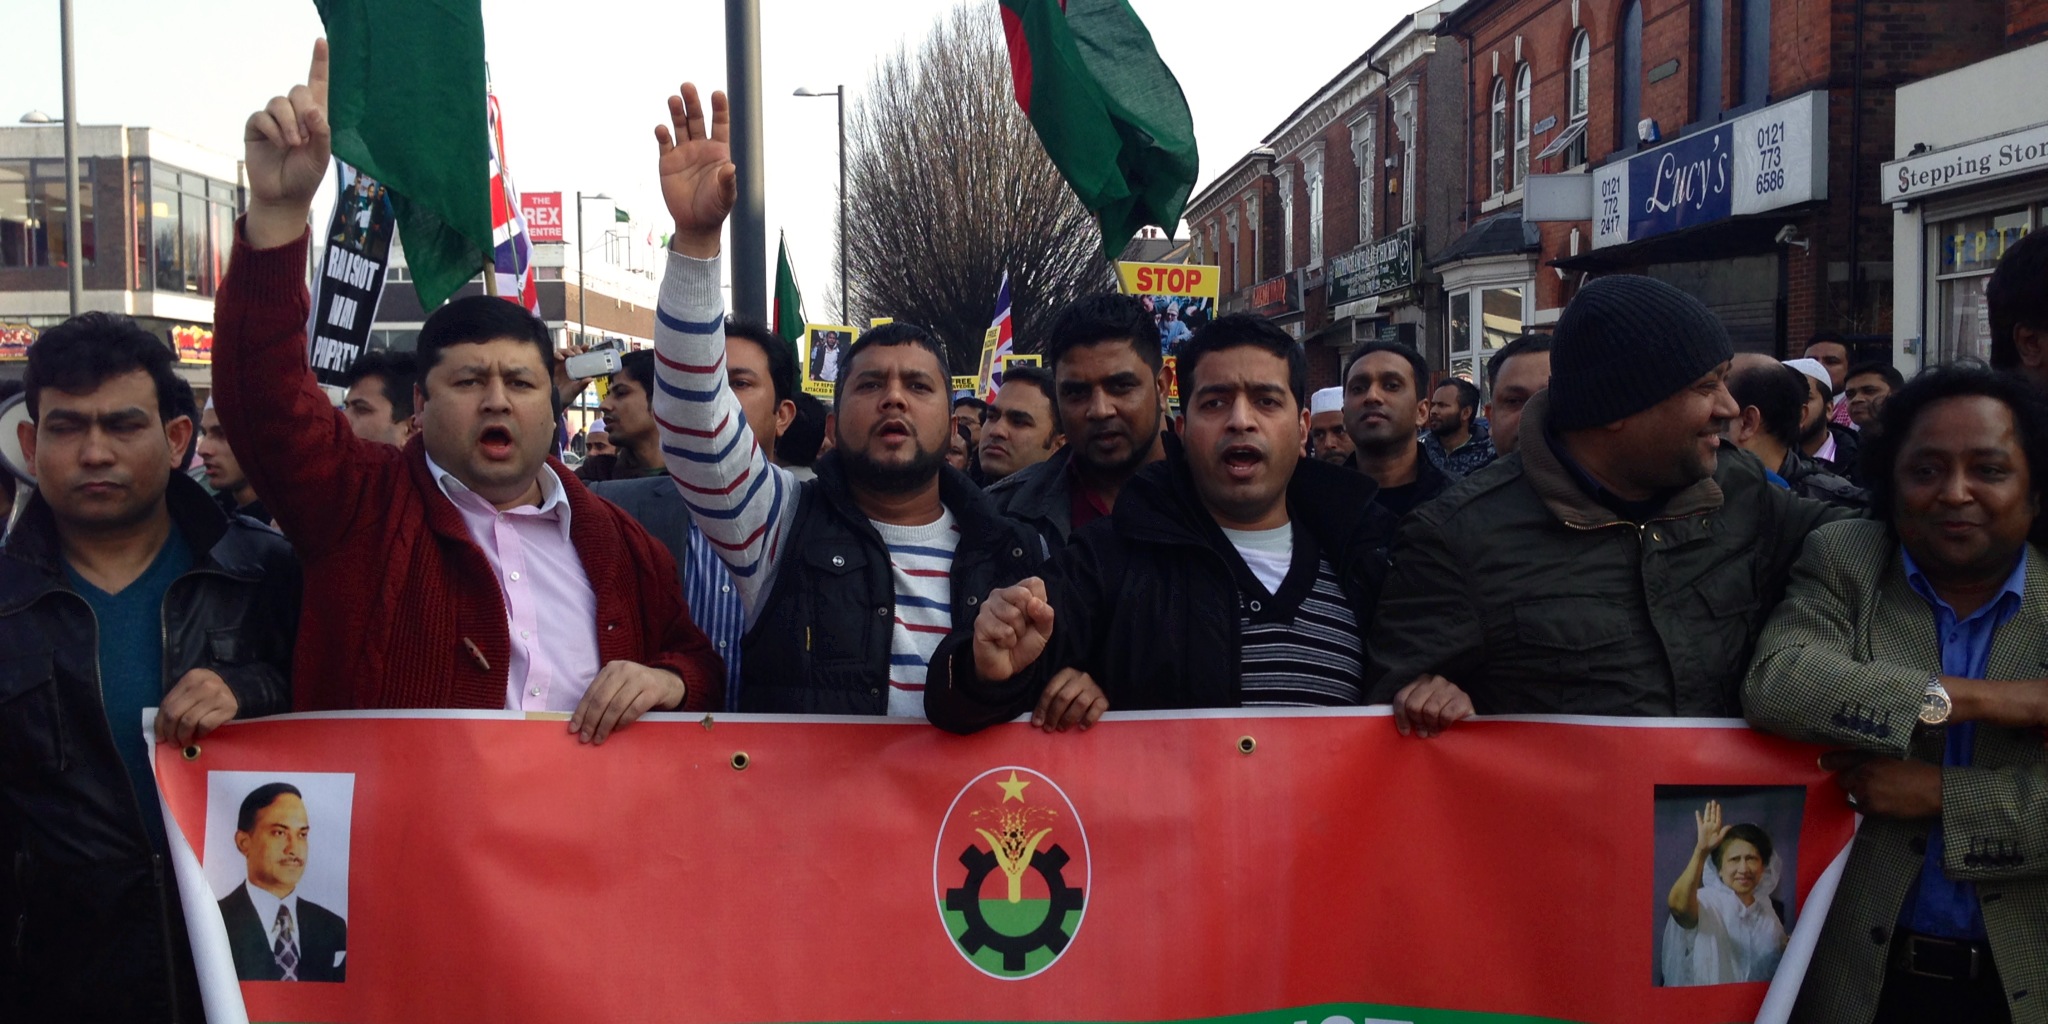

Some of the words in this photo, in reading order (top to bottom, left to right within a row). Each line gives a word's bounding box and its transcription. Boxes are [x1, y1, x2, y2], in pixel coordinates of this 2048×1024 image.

[1757, 121, 1785, 149] 0121
[1760, 145, 1782, 171] 773
[1645, 134, 1728, 214] Lucy's
[1756, 169, 1785, 195] 6586
[1898, 154, 1991, 193] Stepping
[1601, 176, 1621, 198] 0121
[531, 197, 551, 205] THE
[1603, 196, 1618, 217] 772
[523, 207, 560, 226] REX
[1600, 214, 1621, 236] 2417
[529, 227, 562, 237] ENTRE
[1136, 266, 1202, 294] STOP
